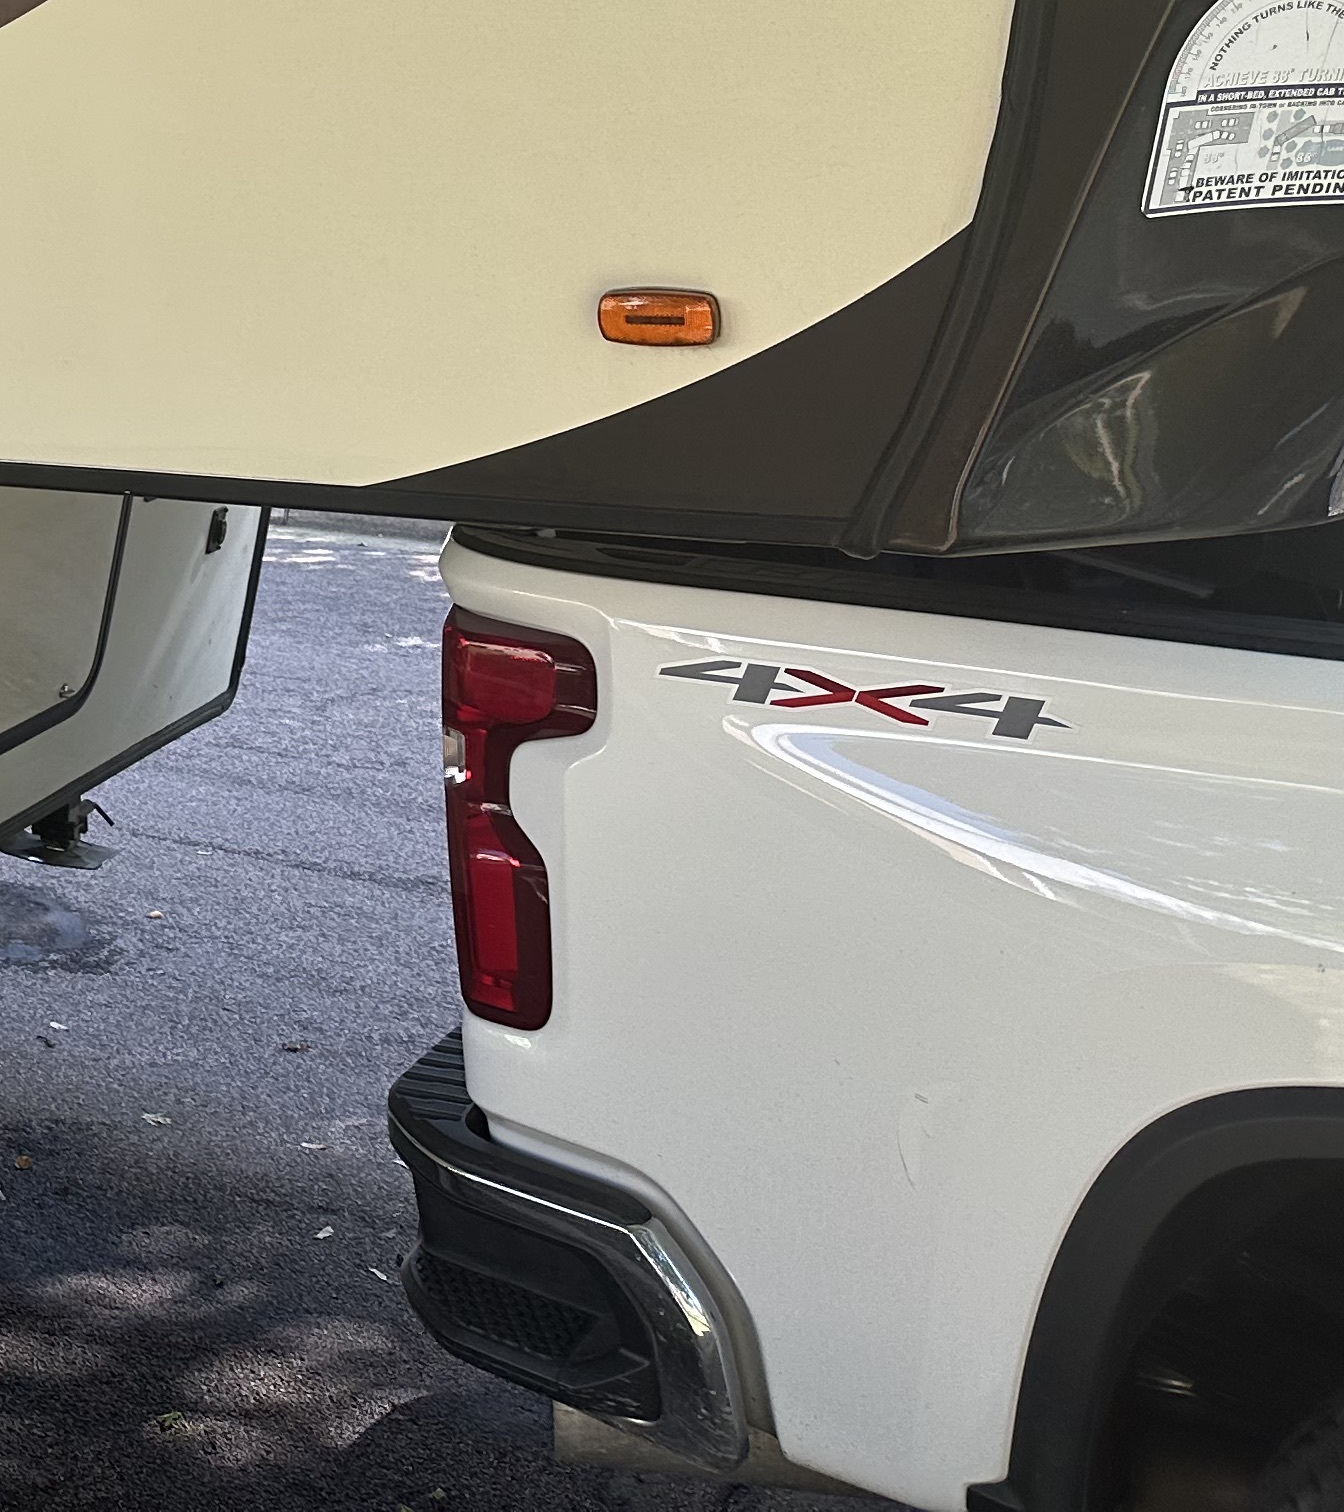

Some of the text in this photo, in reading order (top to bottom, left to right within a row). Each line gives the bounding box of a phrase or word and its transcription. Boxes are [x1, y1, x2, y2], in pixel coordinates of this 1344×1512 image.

[1209, 21, 1252, 71] NOTHING
[1252, 1, 1294, 24] TURNS
[1296, 0, 1324, 10] LIKE
[1204, 70, 1270, 88] ACHIEVE
[1197, 94, 1208, 104] IN
[1208, 93, 1215, 102] A
[1268, 88, 1315, 99] EXTENDED
[1316, 87, 1336, 97] CAB
[1195, 173, 1254, 188] BEWARE
[1258, 171, 1279, 183] OF
[1192, 185, 1266, 203] PATENT
